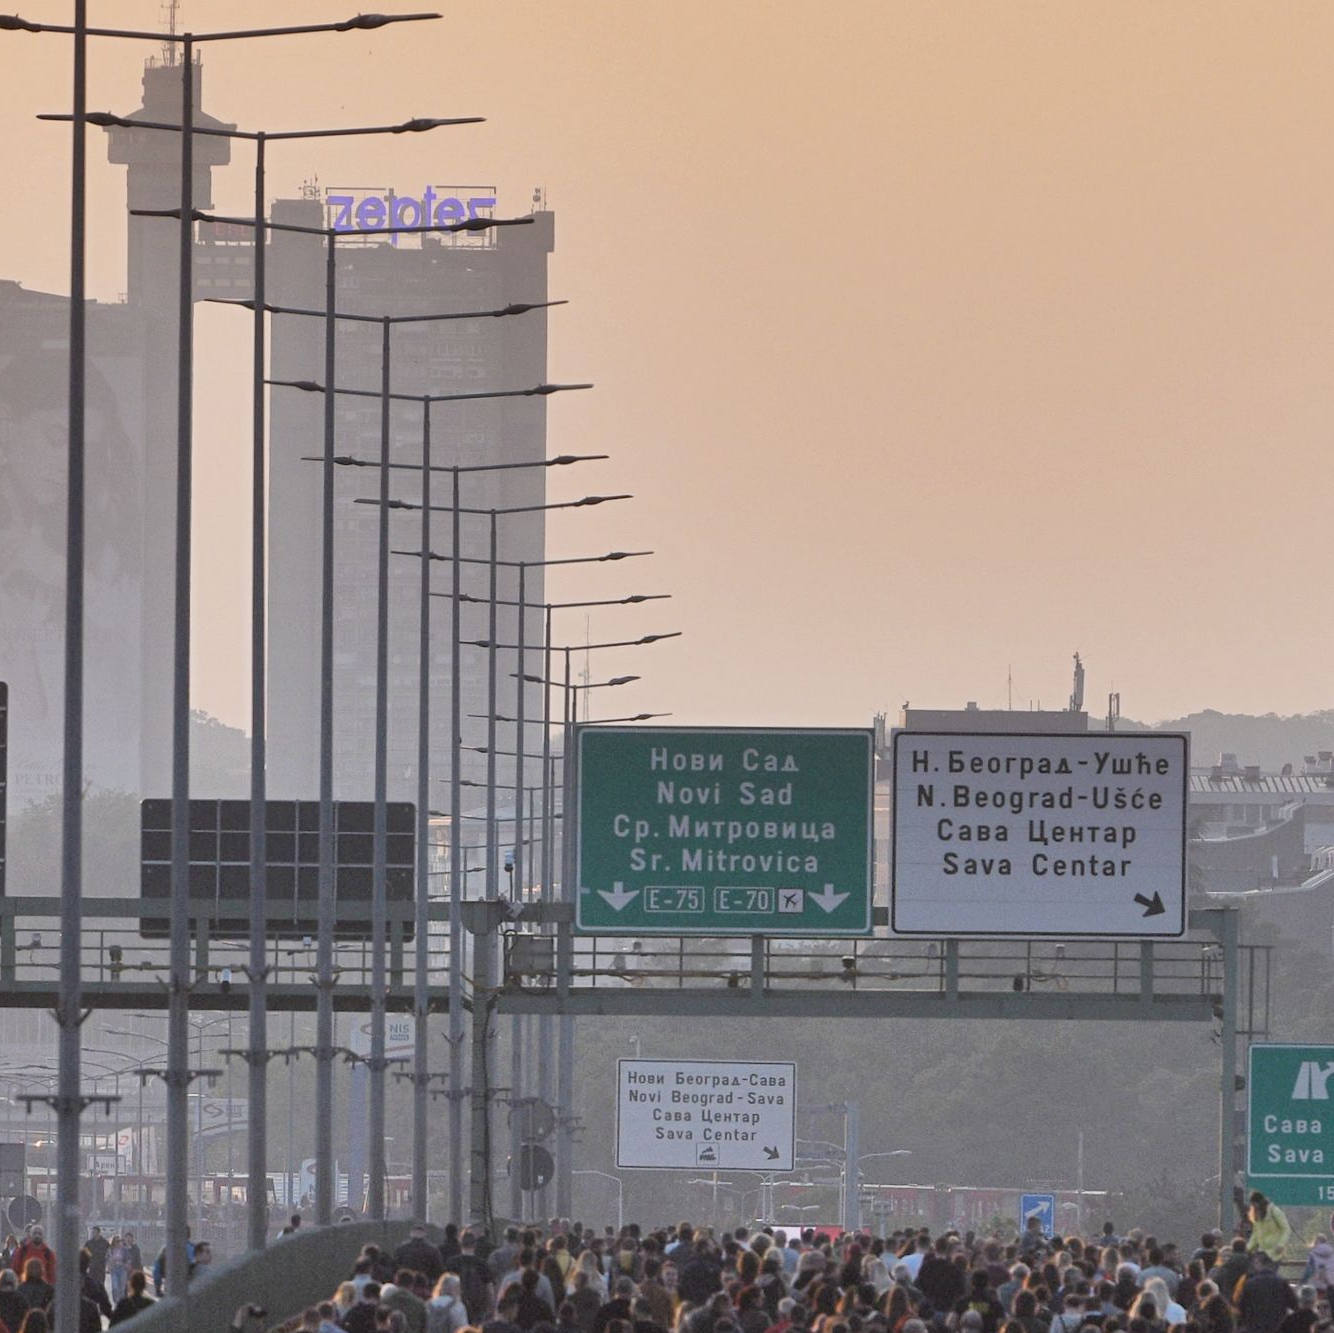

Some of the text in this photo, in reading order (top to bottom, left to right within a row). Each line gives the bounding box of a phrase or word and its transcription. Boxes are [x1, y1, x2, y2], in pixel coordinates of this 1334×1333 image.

[650, 748, 799, 772] Нови Сад
[657, 781, 793, 805] Novi Sad
[937, 819, 1136, 848] Сава Центар
[942, 852, 1131, 876] Sava Centar
[649, 890, 698, 910] E-75
[719, 891, 769, 910] E-70
[628, 1071, 664, 1085] Нови
[629, 1090, 661, 1103] Novi
[653, 1108, 760, 1125] Сава Центар
[1264, 1115, 1322, 1134] Сава
[655, 1127, 757, 1141] Sava Centar
[1268, 1144, 1324, 1164] Sava
